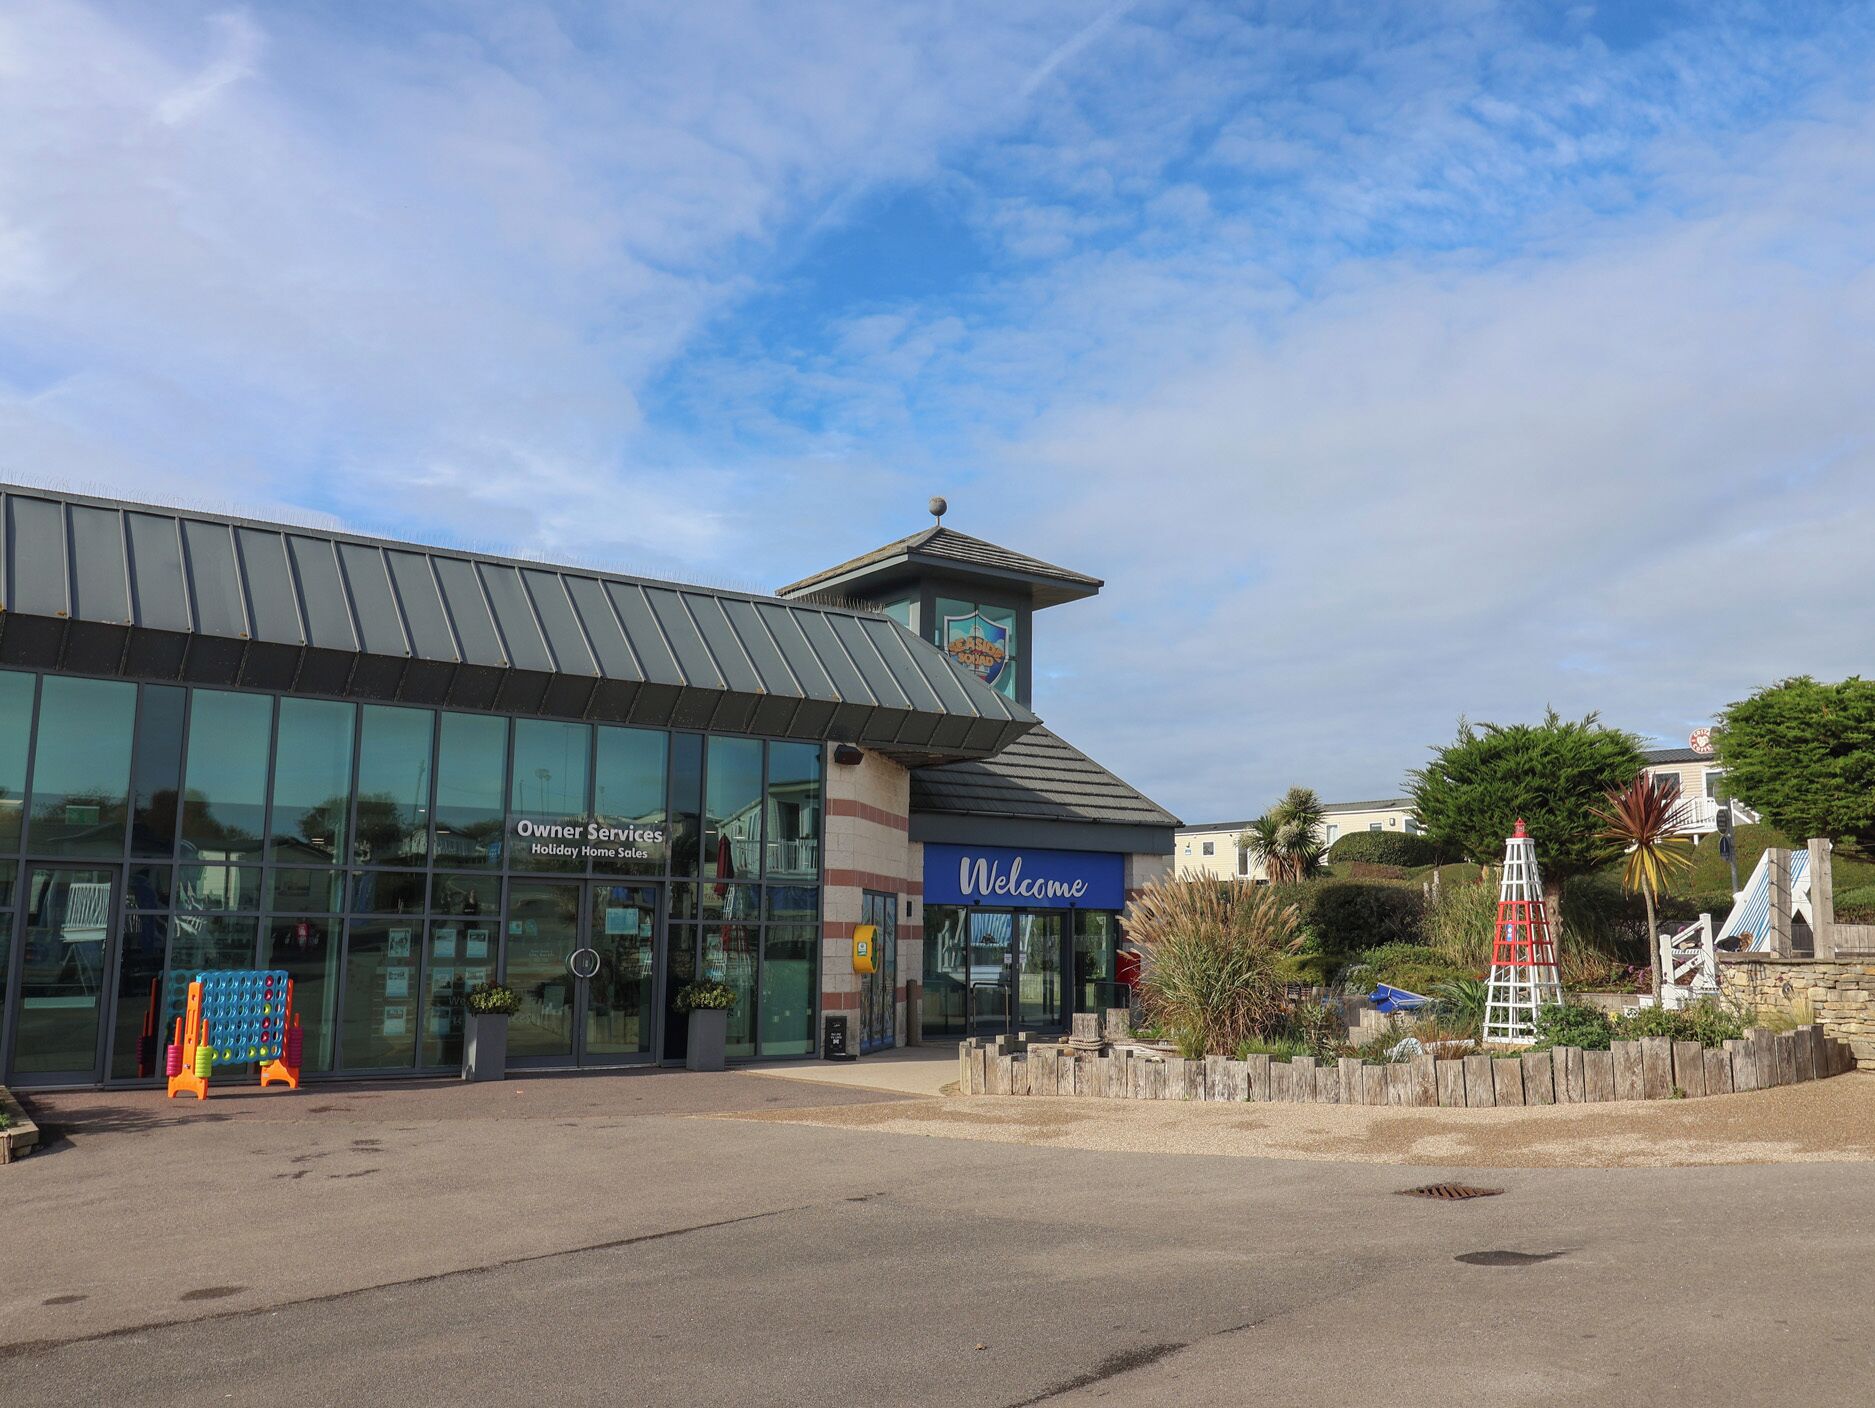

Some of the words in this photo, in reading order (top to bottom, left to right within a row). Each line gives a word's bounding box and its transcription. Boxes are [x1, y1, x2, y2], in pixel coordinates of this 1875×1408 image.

[517, 819, 583, 839] Owner
[587, 823, 663, 843] Services
[531, 843, 578, 859] Holiday
[581, 846, 616, 858] Home
[617, 847, 648, 859] Sales
[959, 856, 1089, 899] Welcome
